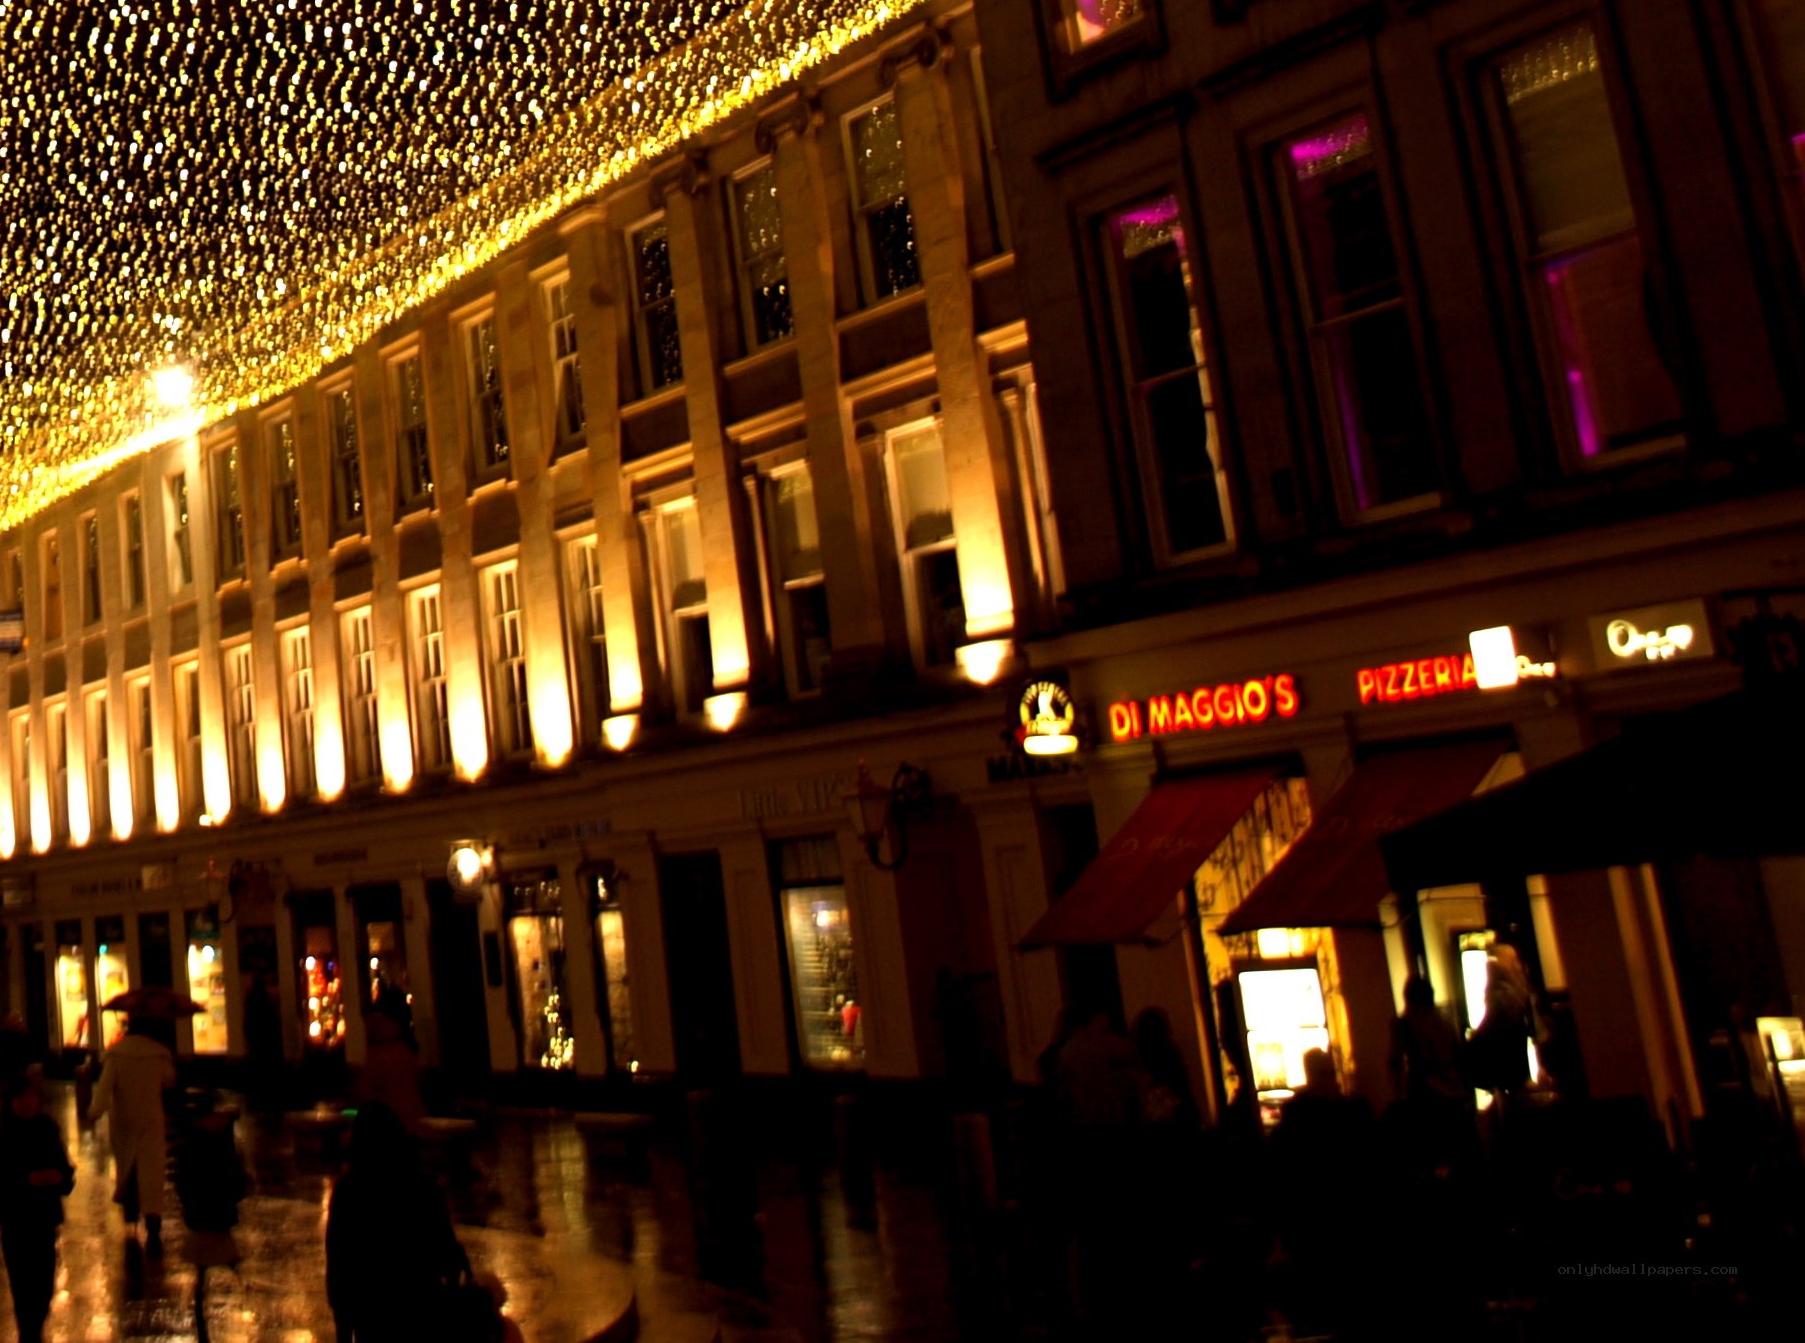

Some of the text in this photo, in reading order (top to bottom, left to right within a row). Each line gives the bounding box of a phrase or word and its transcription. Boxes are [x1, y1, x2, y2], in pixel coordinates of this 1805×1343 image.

[1109, 700, 1142, 742] DI
[1148, 674, 1299, 735] MAGGIO'S
[1357, 654, 1478, 705] PIZZERIA
